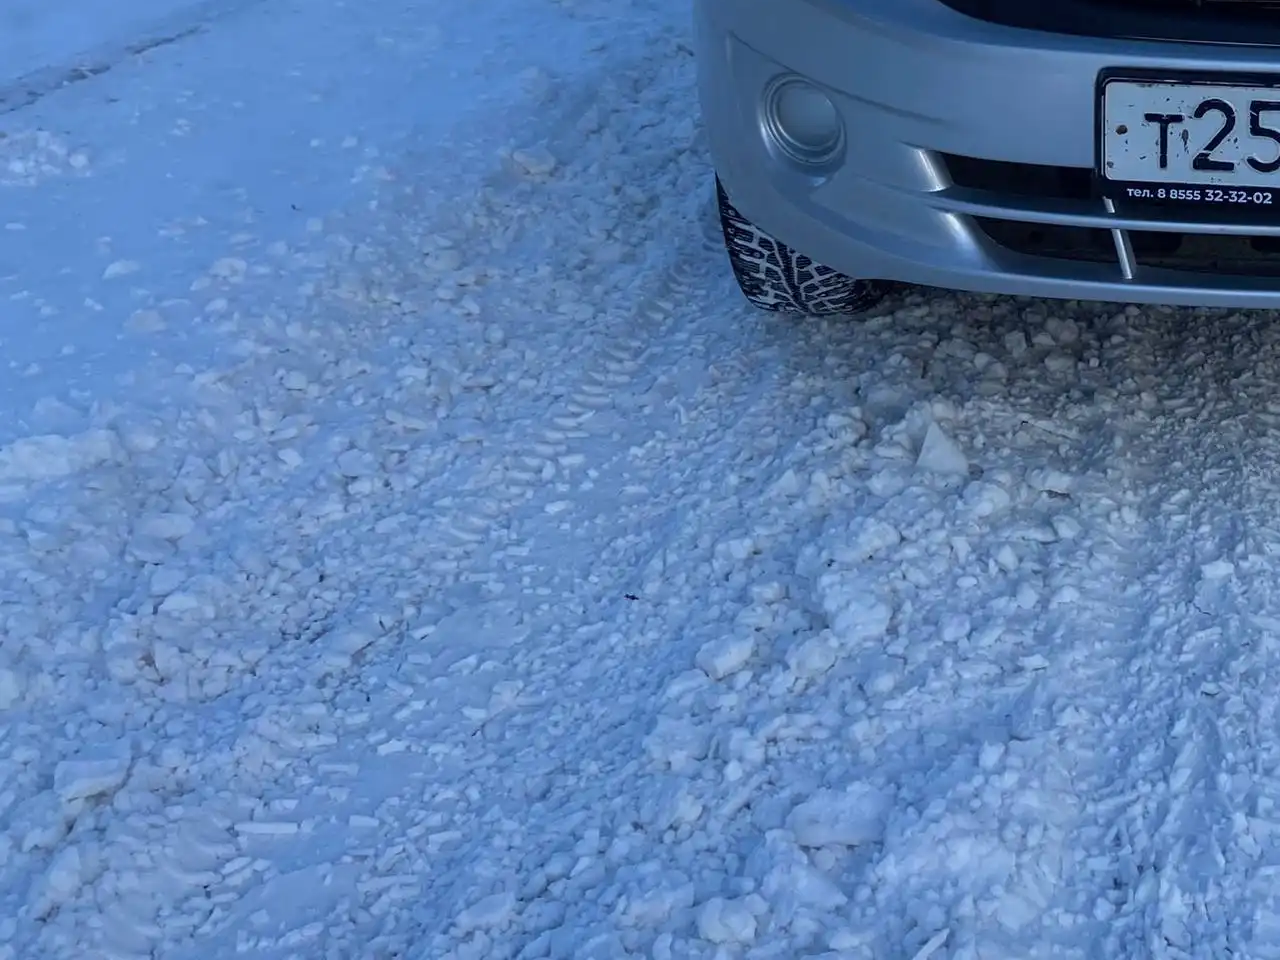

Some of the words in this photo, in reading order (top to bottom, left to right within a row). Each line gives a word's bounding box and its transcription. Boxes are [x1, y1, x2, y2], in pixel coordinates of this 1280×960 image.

[1126, 187, 1154, 198] тел.
[1157, 188, 1166, 199] 8
[1169, 189, 1201, 201] 8555
[1204, 189, 1273, 204] 32-32-02
